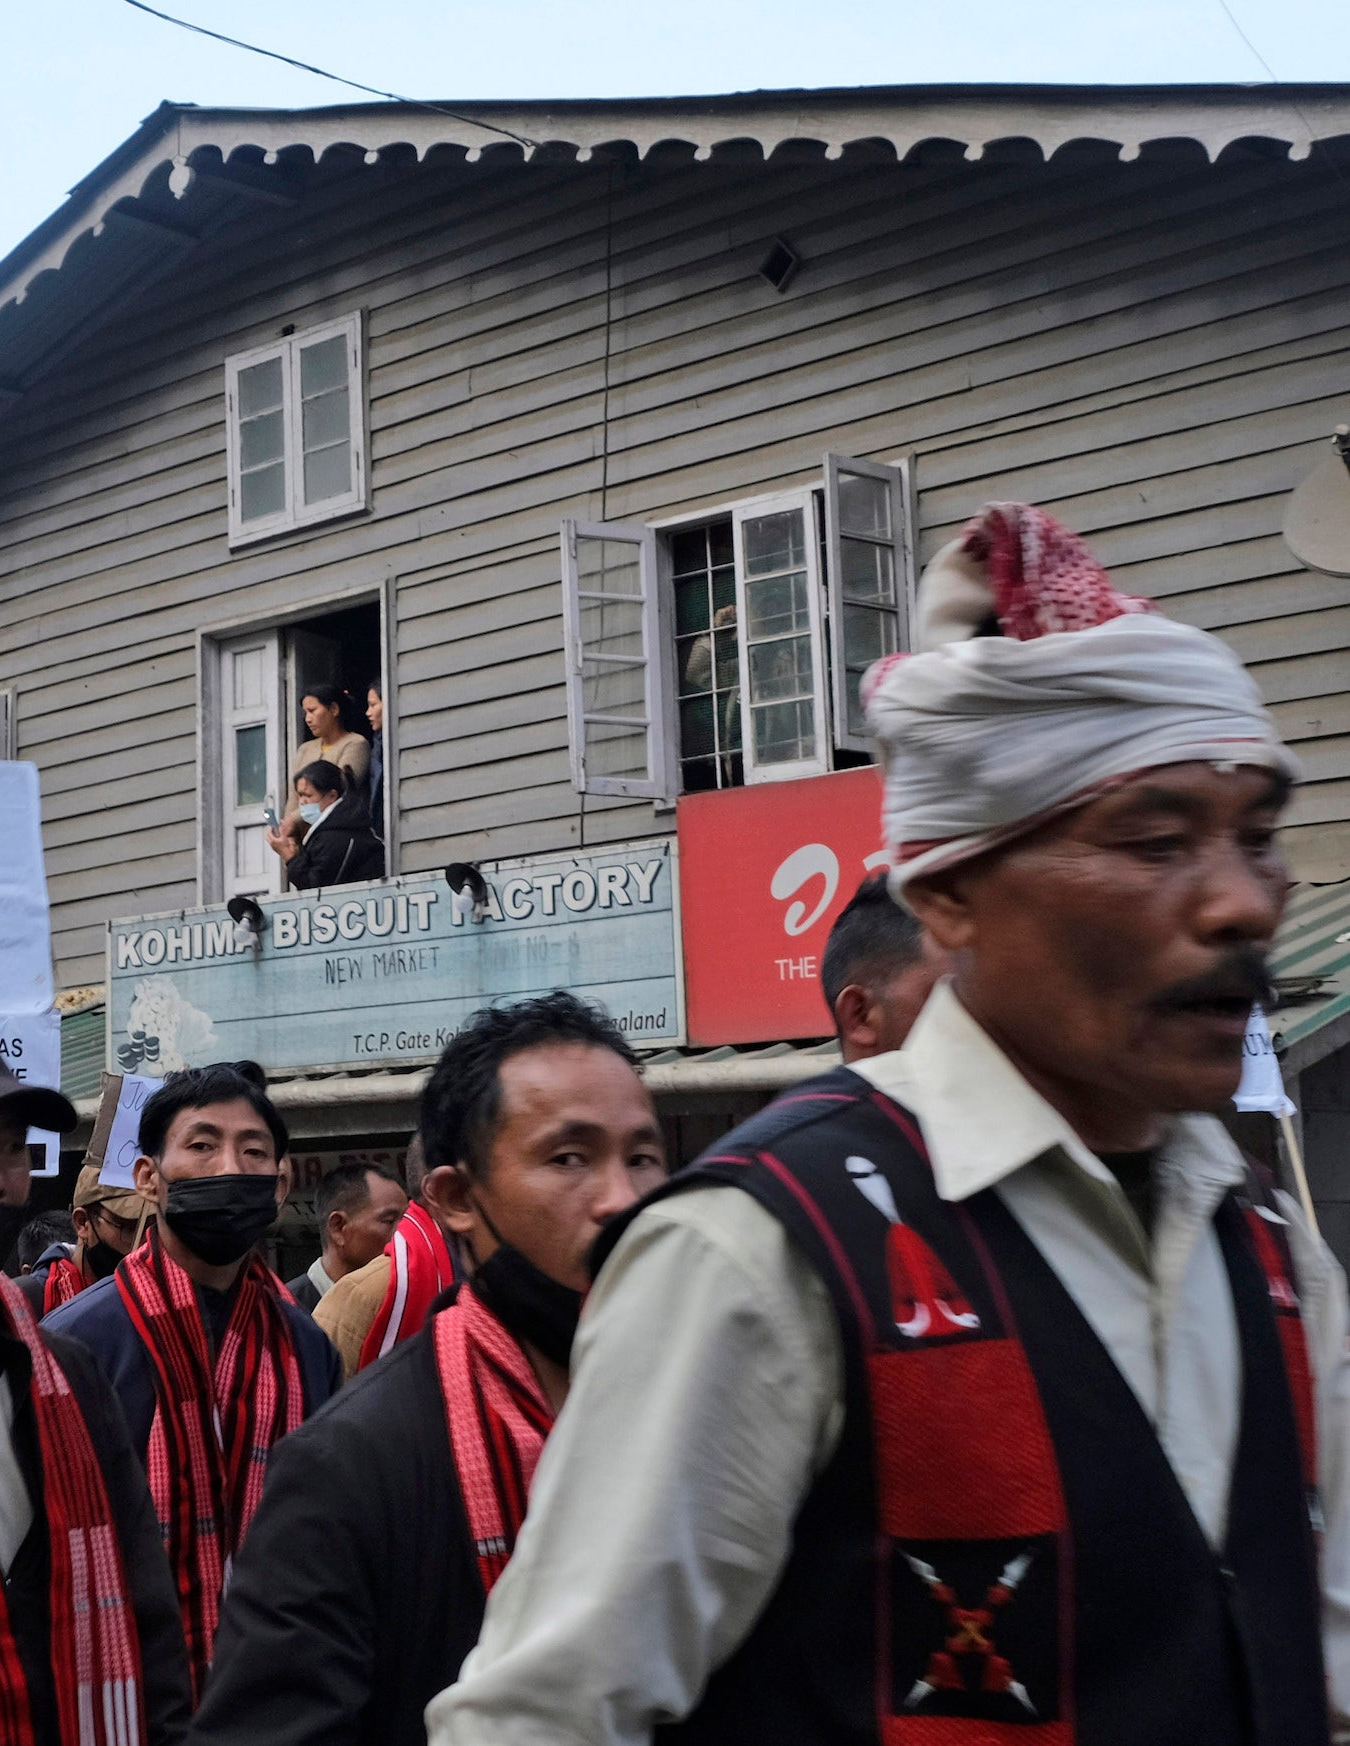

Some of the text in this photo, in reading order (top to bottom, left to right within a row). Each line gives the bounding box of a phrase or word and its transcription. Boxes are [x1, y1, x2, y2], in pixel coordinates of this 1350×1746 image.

[273, 891, 438, 948] BISCUIT
[325, 957, 363, 985] NEW
[373, 947, 439, 978] MARKET
[774, 956, 816, 981] THE
[354, 1033, 391, 1053] T.C.P.
[396, 1031, 431, 1051] Gate
